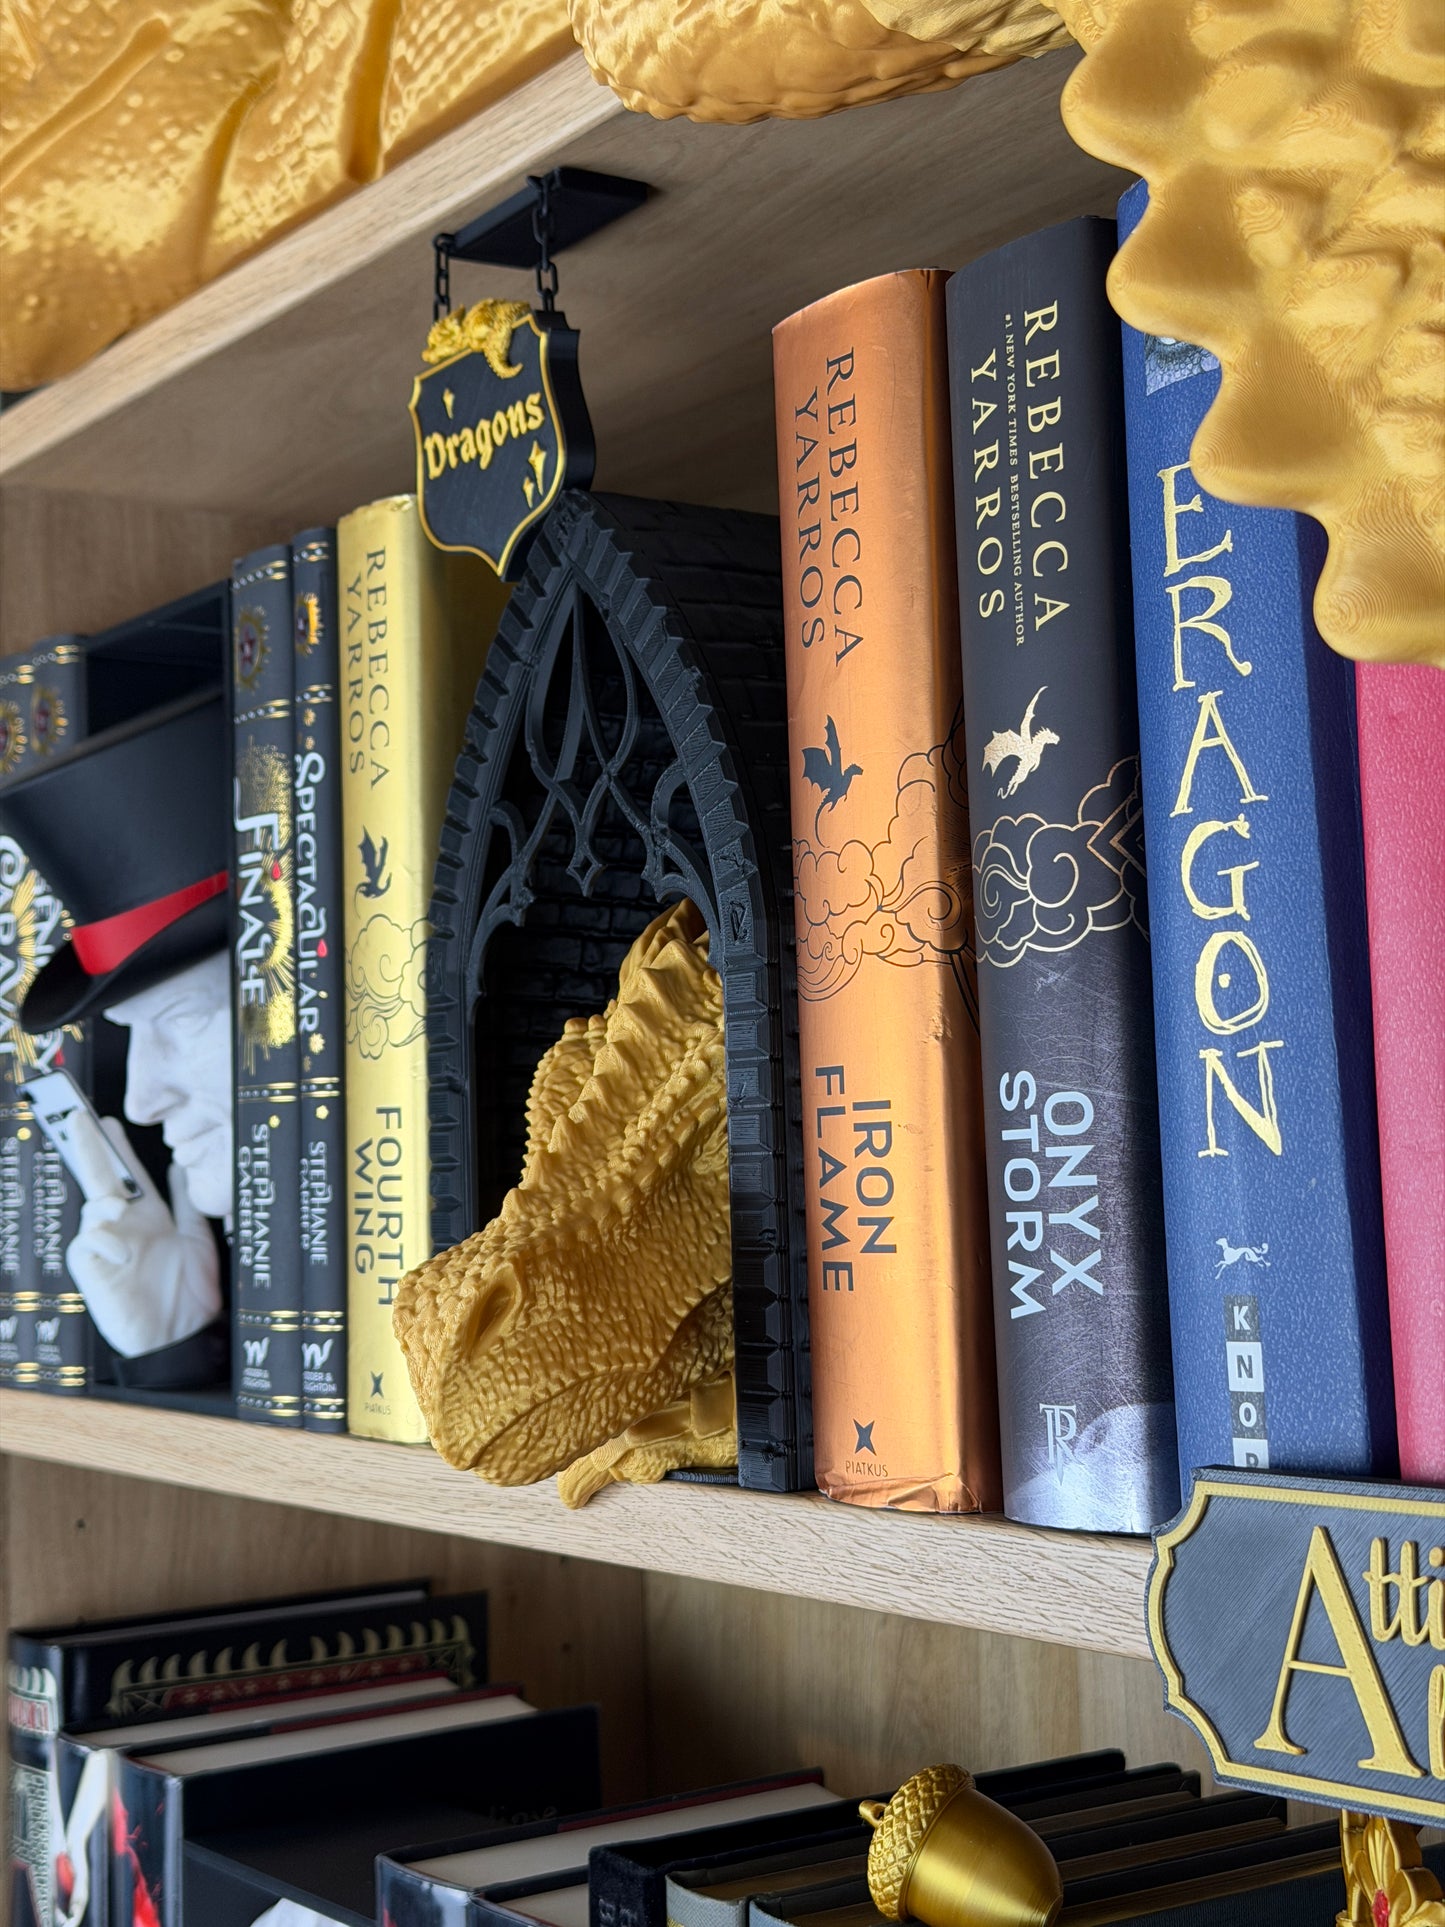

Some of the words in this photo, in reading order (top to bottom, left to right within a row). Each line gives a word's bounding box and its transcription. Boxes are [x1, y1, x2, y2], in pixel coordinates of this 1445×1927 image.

[424, 391, 545, 480] Dragons
[1006, 334, 1015, 368] NEW
[1006, 372, 1017, 415] YORK
[1007, 418, 1018, 467] TIMES
[794, 385, 825, 649] YARROS
[825, 345, 865, 668] REBECCA
[970, 347, 1006, 620] YARROS
[1009, 473, 1022, 577] BESTSELLING
[1023, 299, 1071, 632] REBECCA
[347, 575, 366, 775] YARROS
[366, 545, 391, 790] REBECCA
[1012, 581, 1026, 647] AUTHOR
[1157, 460, 1284, 1158] ERAGON
[252, 1123, 277, 1290] STEPHANIE
[307, 1140, 333, 1267] STEPHANIE
[354, 1137, 376, 1275] WING
[375, 1106, 405, 1306] FOURTH
[815, 1064, 855, 1293] FLAME
[851, 1099, 898, 1255] IRON
[999, 1070, 1047, 1320] STORM
[1043, 1090, 1104, 1296] ONYX
[844, 1459, 889, 1478] PIATKUS
